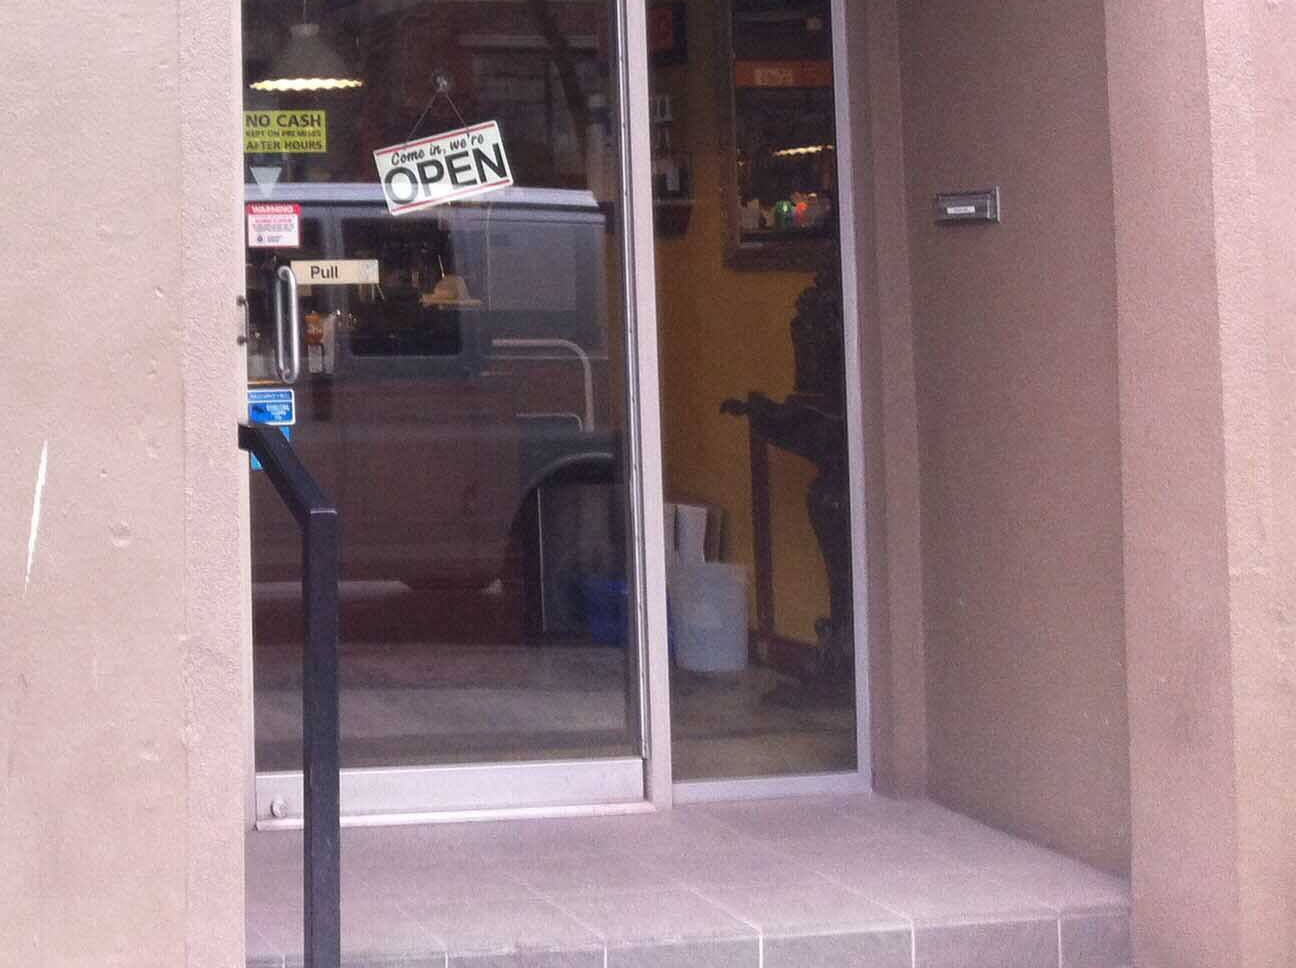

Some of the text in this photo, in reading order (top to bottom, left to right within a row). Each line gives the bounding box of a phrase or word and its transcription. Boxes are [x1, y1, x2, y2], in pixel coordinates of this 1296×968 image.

[245, 114, 321, 128] NO CASH
[246, 140, 322, 150] AFTER HOURS
[391, 149, 425, 165] Come
[384, 142, 508, 205] OPEN
[310, 264, 338, 280] Pull
